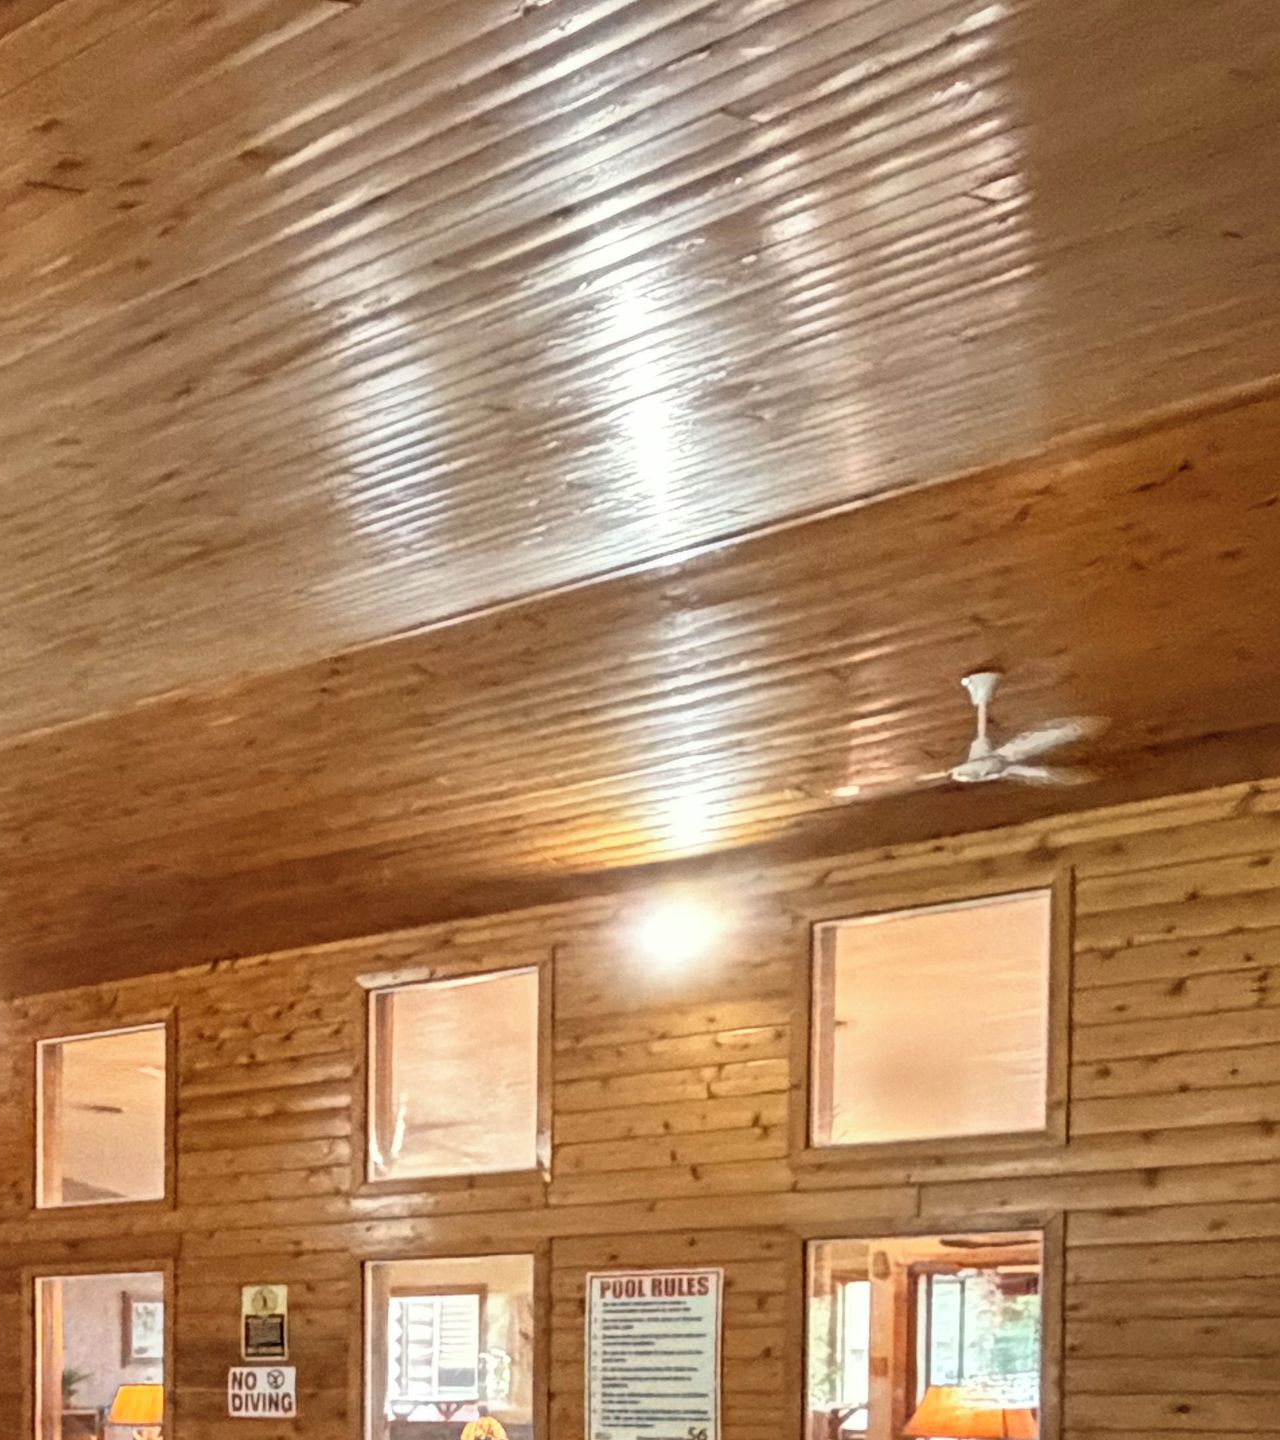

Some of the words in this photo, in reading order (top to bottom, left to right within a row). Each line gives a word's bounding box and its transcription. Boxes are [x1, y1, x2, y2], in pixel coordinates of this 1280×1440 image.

[600, 1278, 646, 1299] POOL
[651, 1276, 709, 1297] RULES
[231, 1371, 257, 1390] NO
[231, 1392, 293, 1413] DIVING
